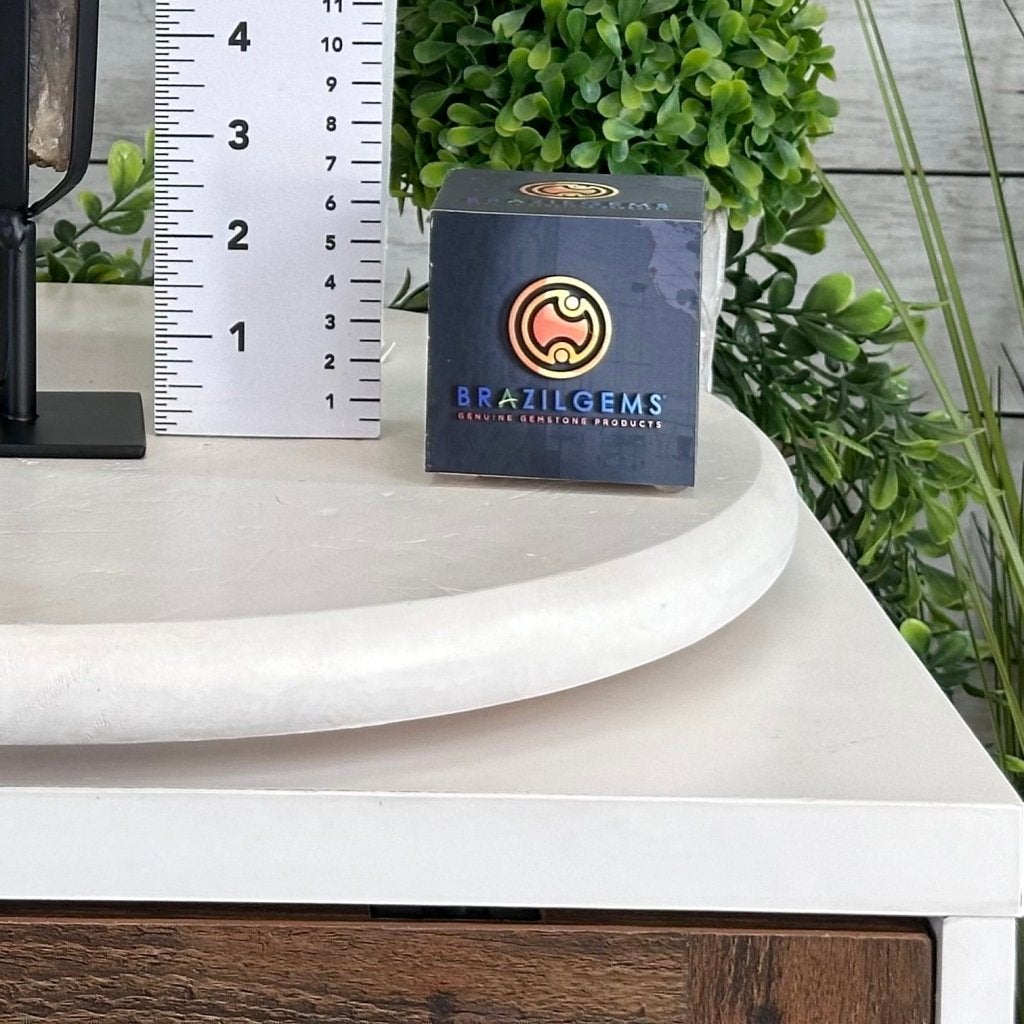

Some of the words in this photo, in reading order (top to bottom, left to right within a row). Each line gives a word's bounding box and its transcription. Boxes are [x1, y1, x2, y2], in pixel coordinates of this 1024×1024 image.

[228, 22, 250, 51] 4
[321, 37, 344, 52] 10
[326, 77, 337, 92] 9
[326, 116, 336, 131] 8
[229, 119, 249, 150] 3
[326, 156, 336, 171] 7
[325, 195, 336, 211] 6
[228, 220, 248, 250] 2
[325, 235, 336, 250] 5
[325, 275, 336, 290] 4
[325, 314, 335, 330] 3
[230, 322, 245, 352] 1
[324, 354, 335, 369] 2
[326, 394, 333, 409] 1
[456, 386, 666, 416] BRAZILGEMS
[457, 411, 513, 422] GENUINE
[520, 414, 588, 426] GEMSTONE
[594, 417, 662, 429] PRODUCTS
